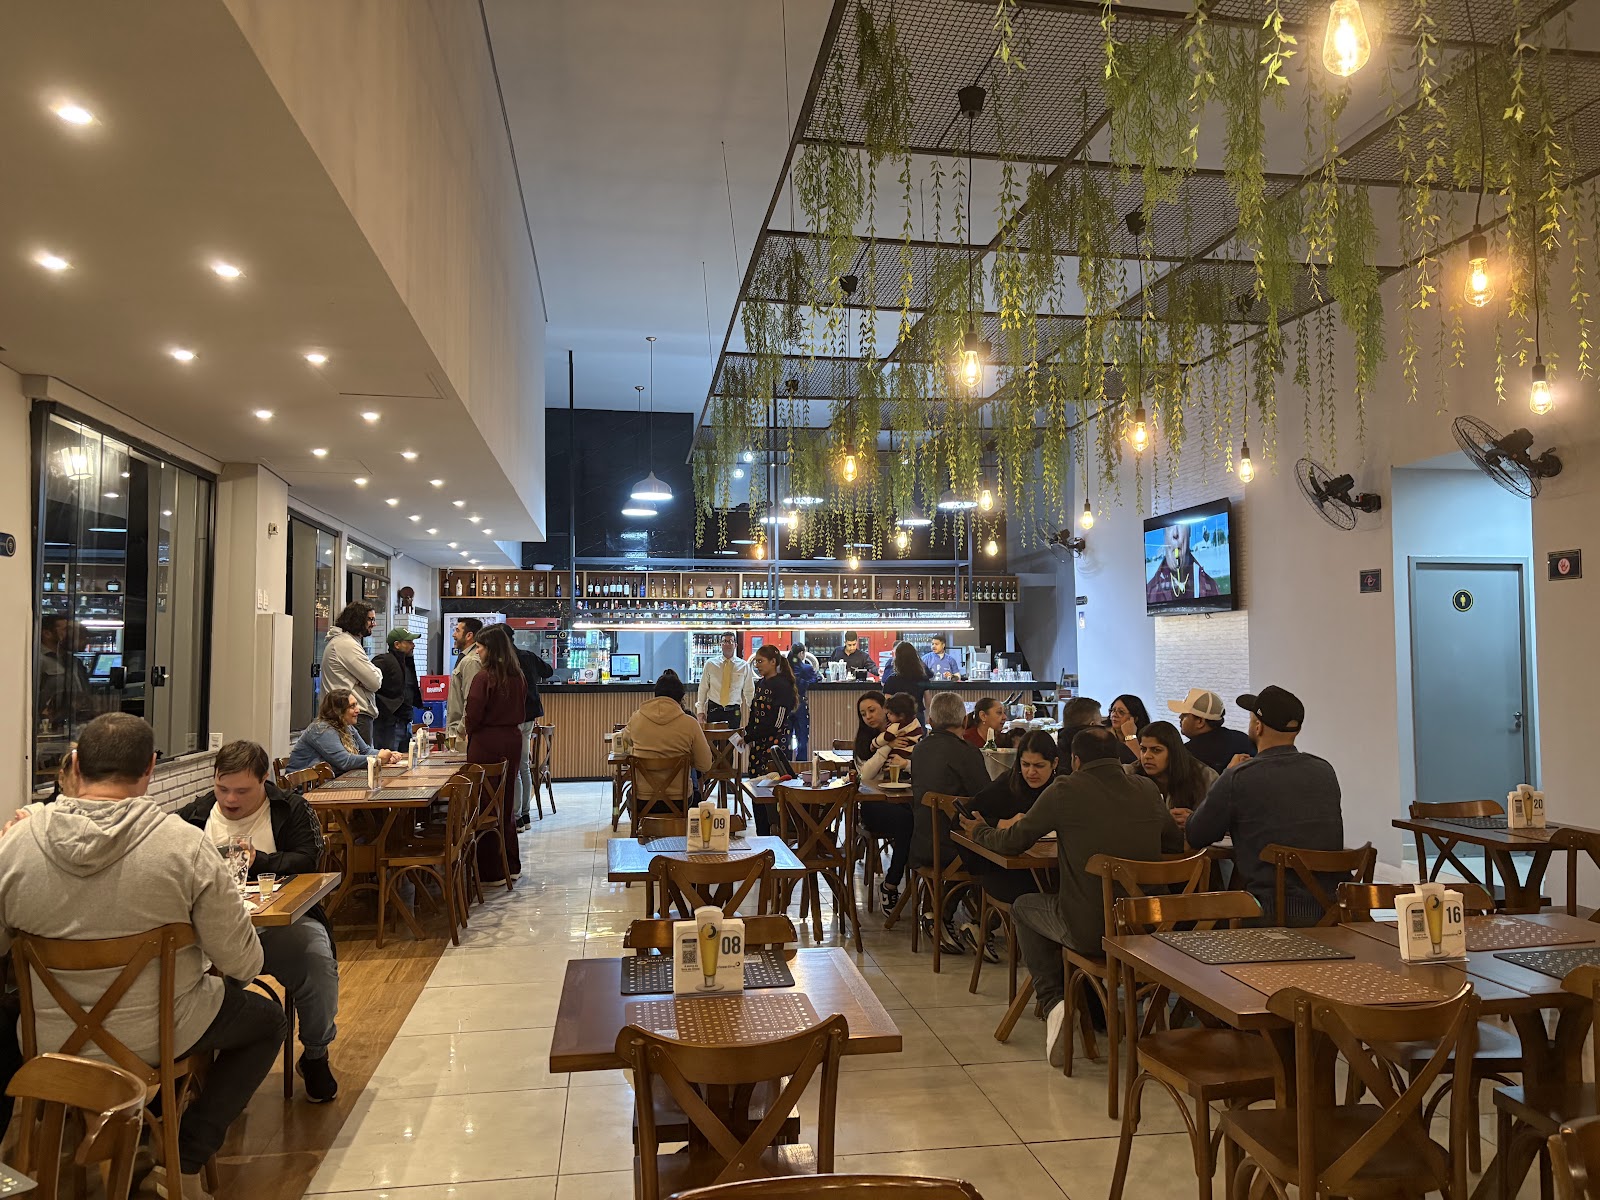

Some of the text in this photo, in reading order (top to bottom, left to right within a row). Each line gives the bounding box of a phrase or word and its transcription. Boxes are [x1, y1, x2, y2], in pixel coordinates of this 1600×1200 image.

[1534, 798, 1543, 809] 20
[714, 817, 726, 830] 09
[1446, 906, 1461, 924] 16
[722, 936, 741, 955] 08
